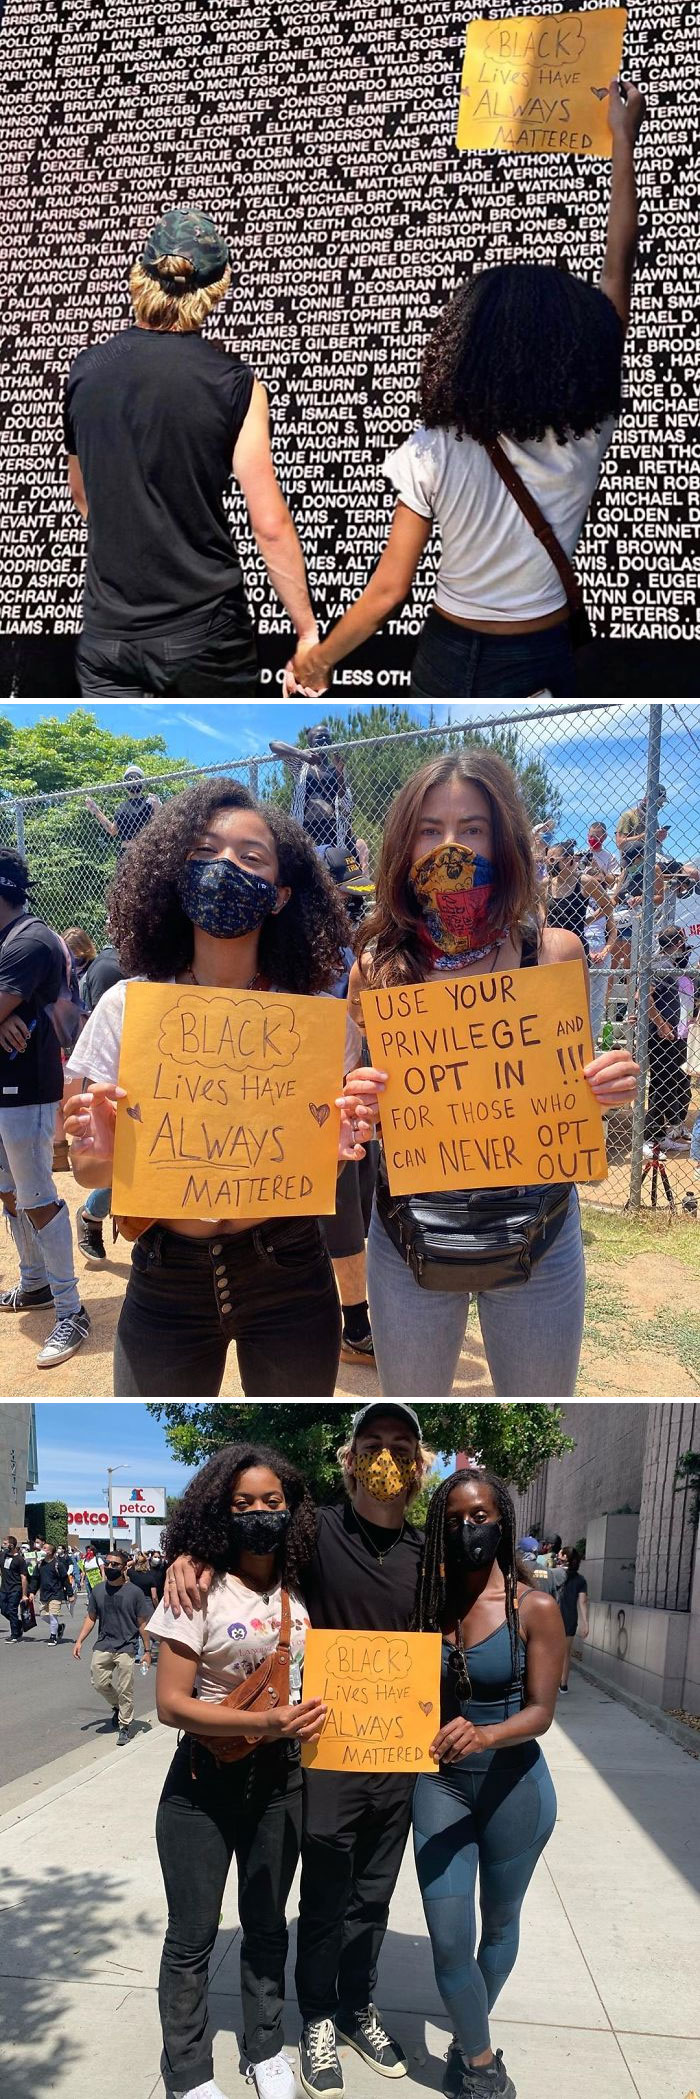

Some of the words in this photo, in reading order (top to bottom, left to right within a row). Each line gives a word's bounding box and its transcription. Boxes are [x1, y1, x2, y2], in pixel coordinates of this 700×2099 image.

[0, 13, 58, 26] BRISBON
[68, 9, 104, 21] JOHN
[107, 2, 181, 18] CRAWFORD
[3, 3, 41, 14] TAMIR
[90, 16, 155, 30] MICHELLE
[158, 10, 228, 25] CUSSEAUX
[62, 32, 100, 44] DAVID
[103, 27, 155, 40] LATHAM
[165, 23, 206, 35] MARIA
[210, 18, 270, 32] GODINEZ
[281, 13, 330, 26] VICTOR
[334, 8, 376, 21] WHITE
[138, 35, 202, 49] SHERROD
[284, 24, 339, 37] JORDAN
[355, 16, 418, 32] DARNELL
[424, 11, 482, 25] DAYRON
[489, 3, 563, 19] STAFFORD
[55, 55, 93, 66] KEITH
[97, 49, 162, 64] ATKINSON
[174, 44, 222, 57] ASKARI
[227, 39, 290, 53] ROBERTS
[401, 26, 448, 39] SCOTT
[124, 59, 186, 73] LASHANO
[203, 53, 259, 66] GILBERT
[269, 49, 317, 62] DANIEL
[367, 41, 406, 54] AURA
[498, 32, 571, 57] BLACK
[60, 77, 100, 89] JOLLY
[136, 70, 190, 84] KENDRE
[242, 62, 295, 75] ALSTON
[308, 56, 369, 70] MICHAEL
[539, 68, 581, 88] HAVE
[64, 99, 116, 112] BRIATAY
[119, 93, 186, 108] MCDUFFIE
[198, 89, 244, 102] TRAVIS
[248, 86, 297, 98] FAISON
[310, 79, 386, 94] LEONARDO
[64, 109, 136, 123] BALANTINE
[143, 104, 201, 118] MBEGBU
[217, 99, 273, 112] SAMUEL
[280, 94, 346, 108] JOHNSON
[365, 87, 434, 102] EMERSON
[473, 90, 570, 122] ALWAYS
[49, 122, 104, 136] WALKER
[118, 116, 195, 131] NYOCOMUS
[278, 106, 342, 120] CHARLES
[348, 101, 408, 116] EMMETT
[103, 129, 176, 144] JERMONTE
[181, 124, 250, 138] FLETCHER
[318, 116, 385, 130] JACKSON
[640, 117, 698, 132] BROWN
[38, 148, 84, 160] HODGE
[95, 143, 150, 156] RONALD
[241, 134, 292, 147] YVETTE
[296, 128, 382, 144] HENDERSON
[493, 127, 592, 149] MATTERED
[635, 131, 688, 146] JAMES
[40, 158, 99, 172] DENZELL
[103, 154, 164, 168] CURNELL
[176, 150, 232, 163] PEARLIE
[374, 137, 420, 151] EVANS
[42, 170, 105, 184] CHARLEY
[108, 166, 171, 180] LEUNDEU
[175, 161, 241, 175] KEUNANG
[253, 155, 333, 170] DOMINIQUE
[403, 148, 447, 162] LEWIS
[170, 174, 229, 188] TERRELL
[232, 170, 306, 184] ROBINSON
[498, 152, 570, 168] ANTHONY
[30, 207, 100, 220] HARRISON
[110, 204, 158, 216] DANIEL
[459, 182, 514, 196] PHILLIP
[518, 178, 585, 192] WATKINS
[46, 194, 116, 208] RAUPHAEL
[120, 190, 177, 203] THOMAS
[188, 186, 234, 199] SANDY
[356, 175, 427, 189] MATTHEW
[504, 165, 573, 180] VERNICIA
[247, 207, 304, 221] CARLOS
[308, 202, 393, 218] DAVENPORT
[526, 190, 600, 205] BERNARD
[639, 198, 690, 212] ALLEN
[38, 232, 86, 244] TOWNS
[245, 220, 296, 234] DUSTIN
[352, 214, 410, 228] GLOVER
[60, 242, 124, 256] MARKELL
[332, 228, 394, 242] PERKINS
[405, 222, 512, 238] CHRISTOPHER
[516, 218, 566, 232] JONES
[11, 256, 89, 271] MCDONALD
[245, 245, 313, 259] JACKSON
[523, 230, 586, 245] RAASON
[28, 269, 87, 283] MARCUS
[279, 256, 348, 270] MONIQUE
[400, 250, 474, 264] DECKARD
[484, 245, 556, 260] STEPHON
[8, 297, 52, 309] PAULA
[64, 294, 101, 307] JUAN
[355, 278, 436, 294] DEOSARAN
[24, 282, 81, 296] LAMONT
[240, 270, 342, 286] CHRISTOPHER
[371, 264, 454, 279] ANDERSON
[56, 306, 122, 320] BERNARD
[292, 296, 345, 310] LONNIE
[352, 292, 430, 308] FLEMMING
[15, 334, 88, 348] MARQUISE
[248, 325, 297, 338] JAMES
[31, 321, 88, 334] RONALD
[12, 348, 54, 361] JAMIE
[306, 336, 368, 350] GILBERT
[332, 349, 387, 362] DENNIS
[286, 378, 354, 392] WILBURN
[302, 364, 368, 378] ARMAND
[296, 392, 368, 406] WILLIAMS
[274, 422, 338, 435] MARLON
[302, 495, 378, 508] DONOVAN
[311, 479, 385, 493] WILLIAMS
[606, 492, 683, 506] MICHAEL
[598, 508, 669, 522] GOLDEN
[616, 540, 682, 554] BROWN
[632, 590, 695, 605] OLIVER
[612, 606, 679, 622] PETERS
[375, 988, 429, 1021] USE
[445, 975, 516, 1011] YOUR
[180, 1012, 283, 1058] BLACK
[381, 1014, 542, 1058] PRIVILEGE
[556, 1015, 584, 1037] AND
[153, 1063, 228, 1106] Lives
[241, 1074, 297, 1106] HAVE
[404, 1060, 469, 1095] OPT
[495, 1059, 525, 1090] IN
[391, 1104, 434, 1131] FOR
[447, 1098, 516, 1125] THOSE
[530, 1093, 576, 1117] WHO
[149, 1112, 285, 1167] ALWAYS
[392, 1147, 427, 1169] CAN
[438, 1135, 523, 1176] NEVER
[537, 1118, 589, 1148] OPT
[537, 1147, 600, 1180] OUT
[181, 1174, 313, 1208] MATTERED
[120, 1503, 155, 1515] petco
[338, 1647, 401, 1674] BLACK
[323, 1678, 368, 1704] Lives
[376, 1684, 411, 1704] HAVE
[321, 1708, 404, 1741] ALWAYS
[342, 1745, 423, 1766] MATTERED
